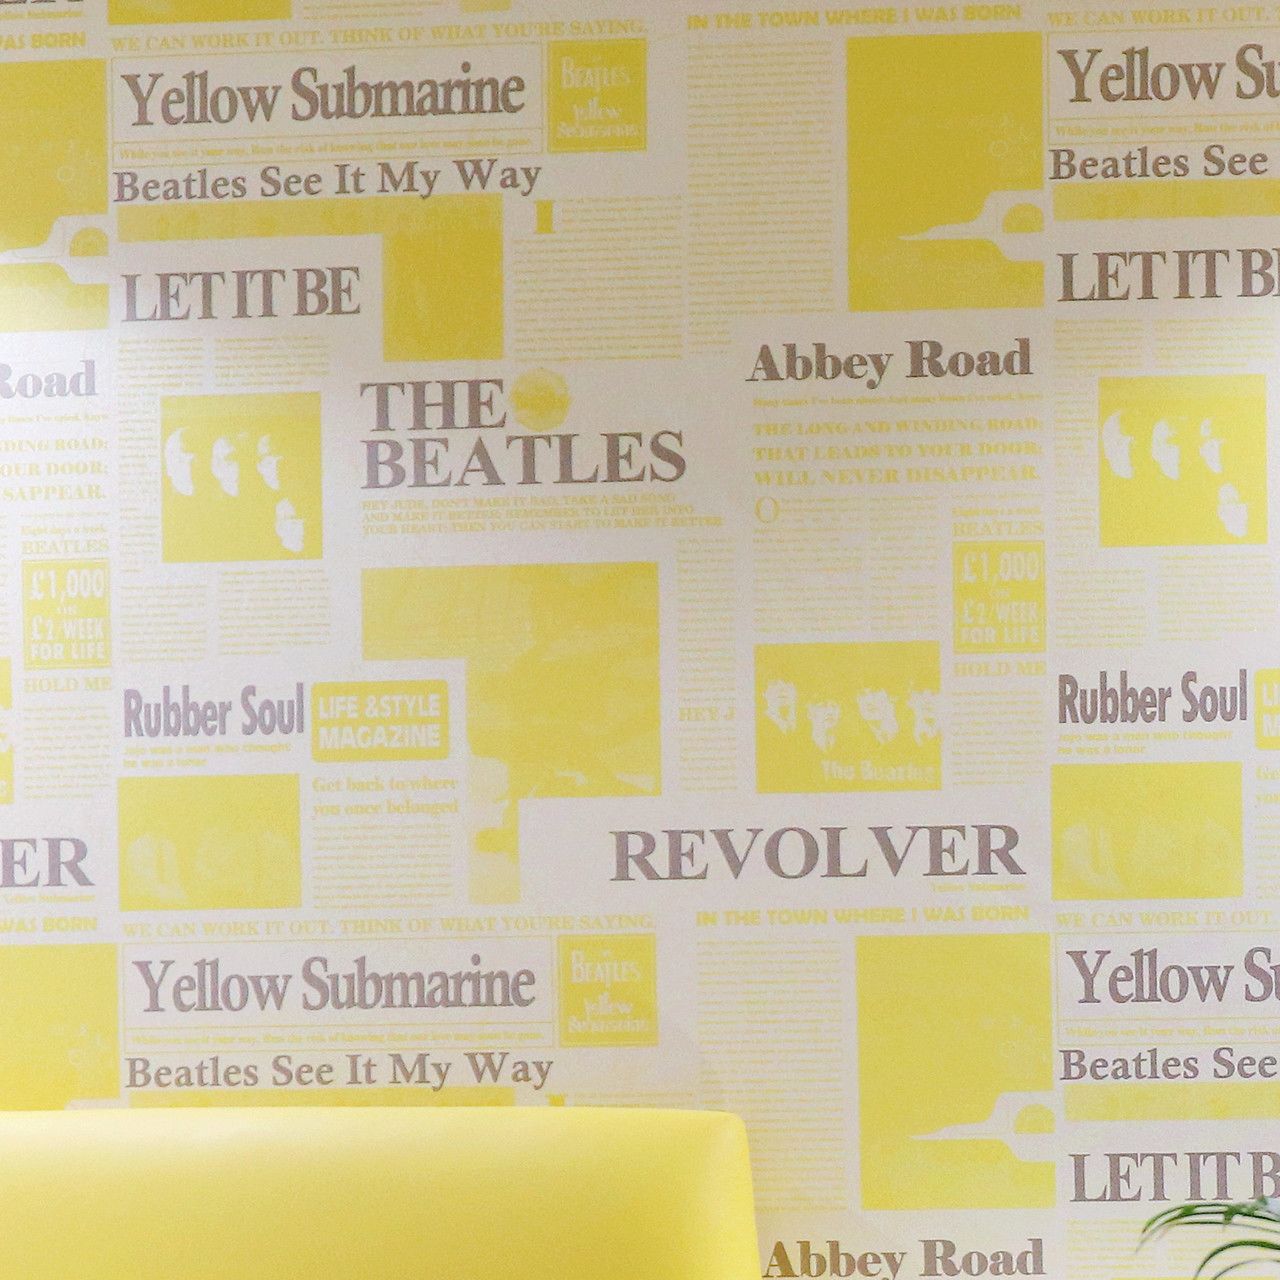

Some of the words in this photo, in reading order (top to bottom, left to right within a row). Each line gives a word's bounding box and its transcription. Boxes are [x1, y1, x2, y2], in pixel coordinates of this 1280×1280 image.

[121, 70, 282, 126] Yellow
[292, 61, 525, 121] Submarine
[1057, 46, 1226, 103] Yellow
[113, 168, 247, 202] Beatles
[260, 166, 322, 198] See
[335, 164, 365, 195] It
[377, 161, 441, 200] My
[453, 159, 542, 197] Way
[1049, 146, 1189, 180] Beatles
[1204, 144, 1268, 177] See
[123, 271, 226, 321] LET
[232, 269, 286, 318] IT
[293, 266, 361, 316] BE
[1057, 251, 1166, 302] LET
[1173, 249, 1230, 299] IT
[745, 343, 893, 390] Abbey
[906, 338, 1033, 378] Road
[360, 379, 507, 431] THE
[361, 430, 687, 490] BEATLES
[124, 685, 232, 738] Rubber
[241, 682, 305, 736] Soul
[318, 695, 358, 720] LIFE
[1059, 671, 1172, 724] Rubber
[1181, 669, 1247, 723] Soul
[319, 724, 441, 749] MAGAZINE
[609, 825, 1027, 882] REVOLVER
[133, 958, 293, 1012] Yellow
[302, 954, 536, 1010] Submarine
[1066, 948, 1234, 1004] Yellow
[126, 1056, 259, 1088] Beatles
[273, 1055, 334, 1086] See
[346, 1054, 377, 1085] It
[389, 1053, 452, 1091] My
[464, 1052, 554, 1090] Way
[1059, 1048, 1199, 1080] Beatles
[1213, 1047, 1277, 1079] See
[1069, 1153, 1177, 1202] LET
[1184, 1152, 1241, 1201] IT
[919, 1238, 1045, 1277] Road
